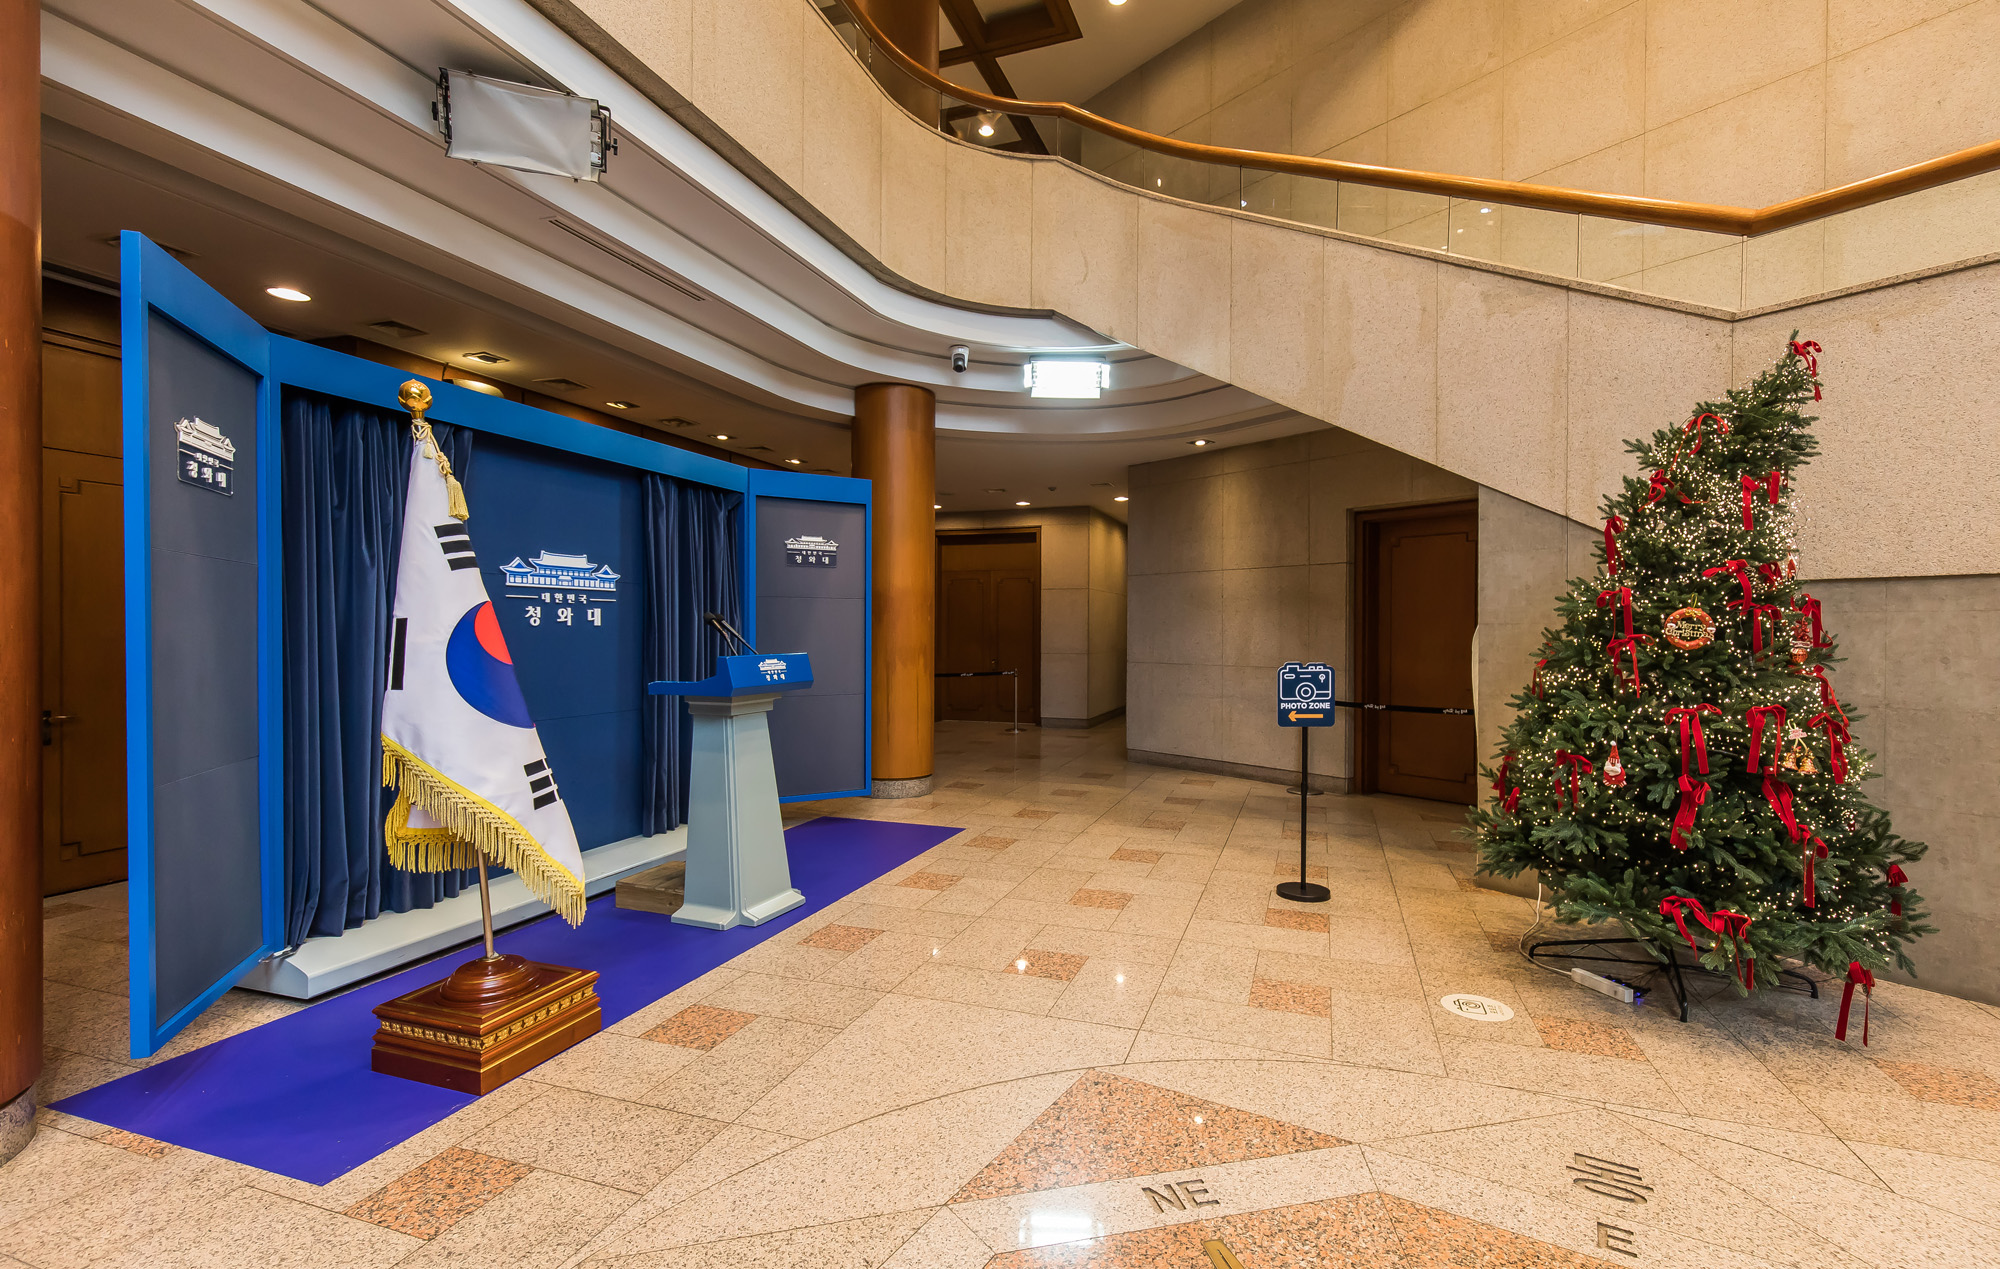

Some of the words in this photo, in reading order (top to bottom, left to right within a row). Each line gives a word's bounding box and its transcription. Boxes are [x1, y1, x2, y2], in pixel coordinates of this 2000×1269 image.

[186, 460, 227, 488] 청와대
[541, 592, 588, 605] 대한민국
[524, 605, 602, 627] 청와대
[1676, 620, 1707, 632] Merry
[1280, 702, 1308, 710] PHOTO
[1308, 702, 1331, 710] ZONE
[1565, 1152, 1655, 1205] 동
[1141, 1179, 1221, 1214] NE
[1596, 1221, 1639, 1258] E
